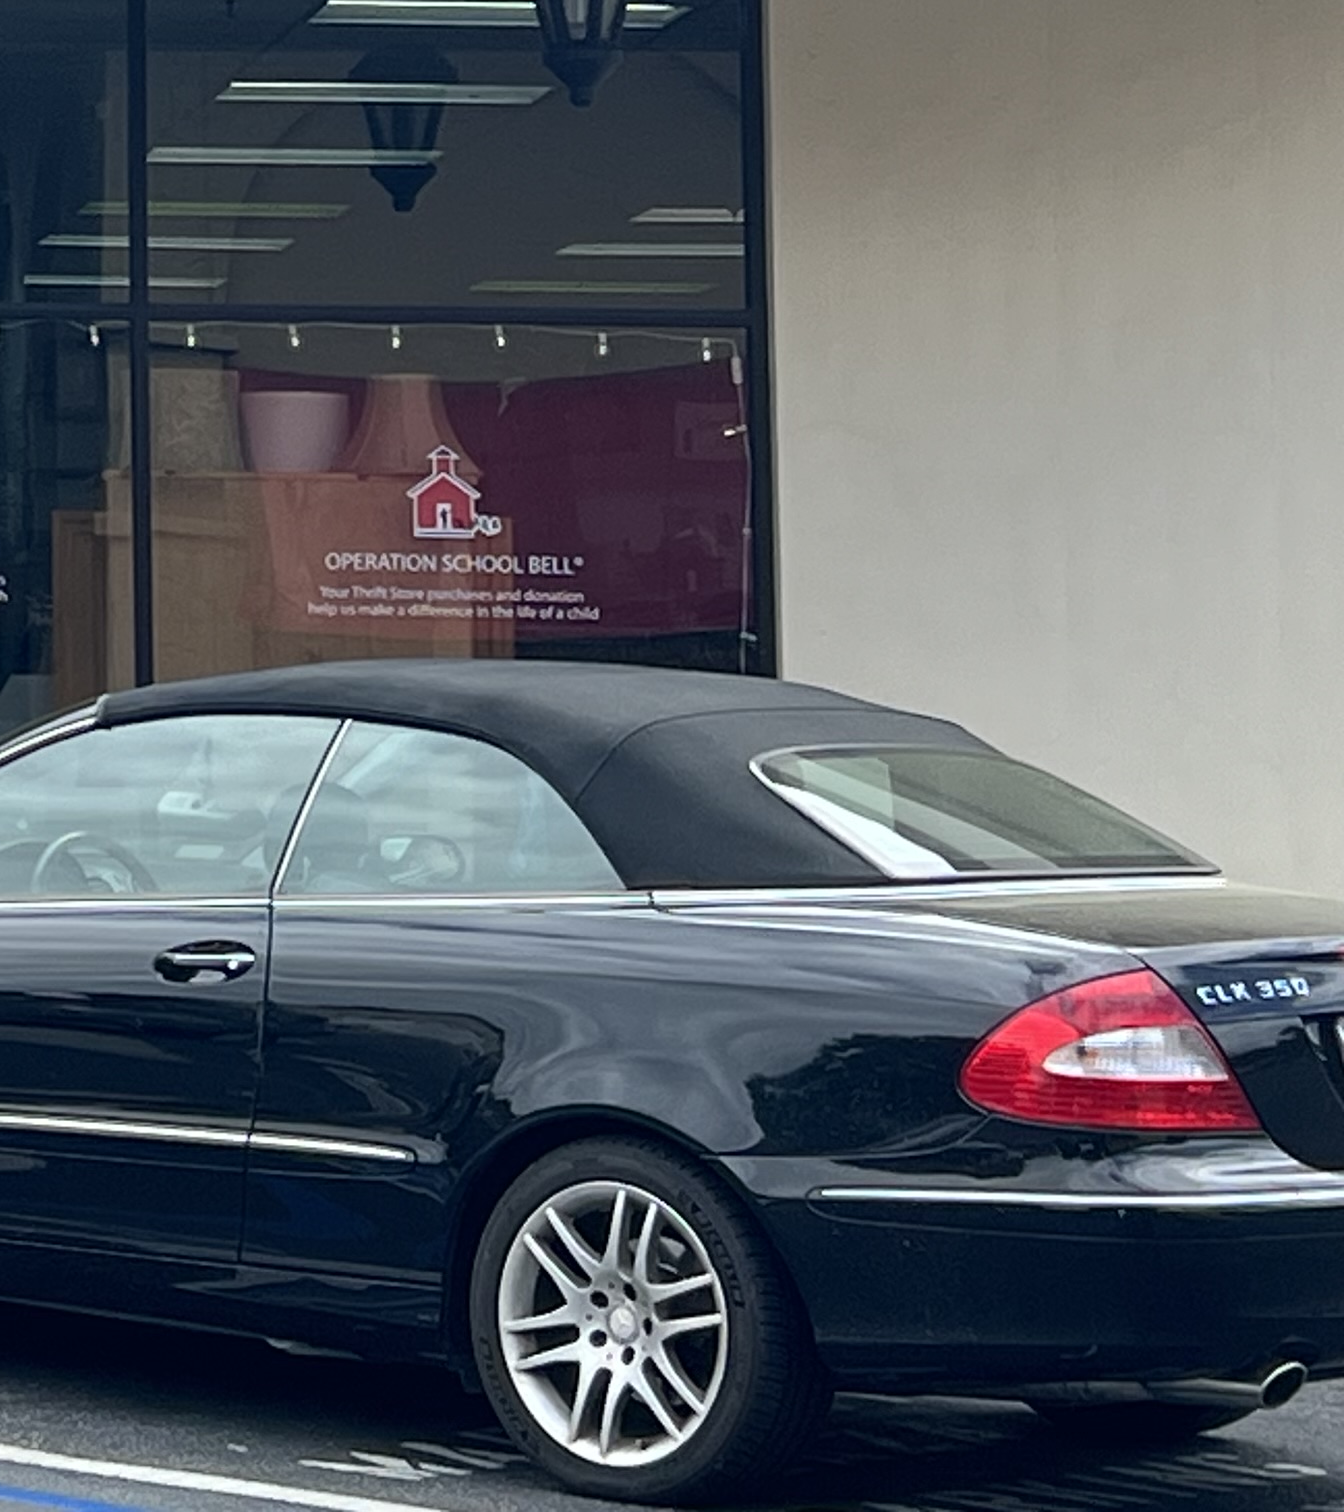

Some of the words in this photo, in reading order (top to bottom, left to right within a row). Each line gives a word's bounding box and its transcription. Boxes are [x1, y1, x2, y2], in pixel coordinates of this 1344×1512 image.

[324, 552, 437, 571] OPERATION
[441, 554, 524, 574] SCHOOL
[319, 585, 350, 599] Your
[351, 585, 387, 599] Thrift
[389, 586, 424, 600] Store
[427, 588, 492, 602] purchases
[496, 589, 522, 601] and
[307, 601, 338, 617] help
[340, 605, 356, 616] us
[357, 603, 395, 616] make
[397, 606, 405, 616] a
[407, 604, 474, 618] difference
[476, 605, 489, 617] in
[492, 605, 513, 618] the
[516, 605, 537, 618] life
[539, 606, 554, 620] of
[555, 608, 564, 619] a
[566, 606, 600, 620] child
[1196, 979, 1251, 1006] CLK
[1254, 976, 1310, 1000] 350
